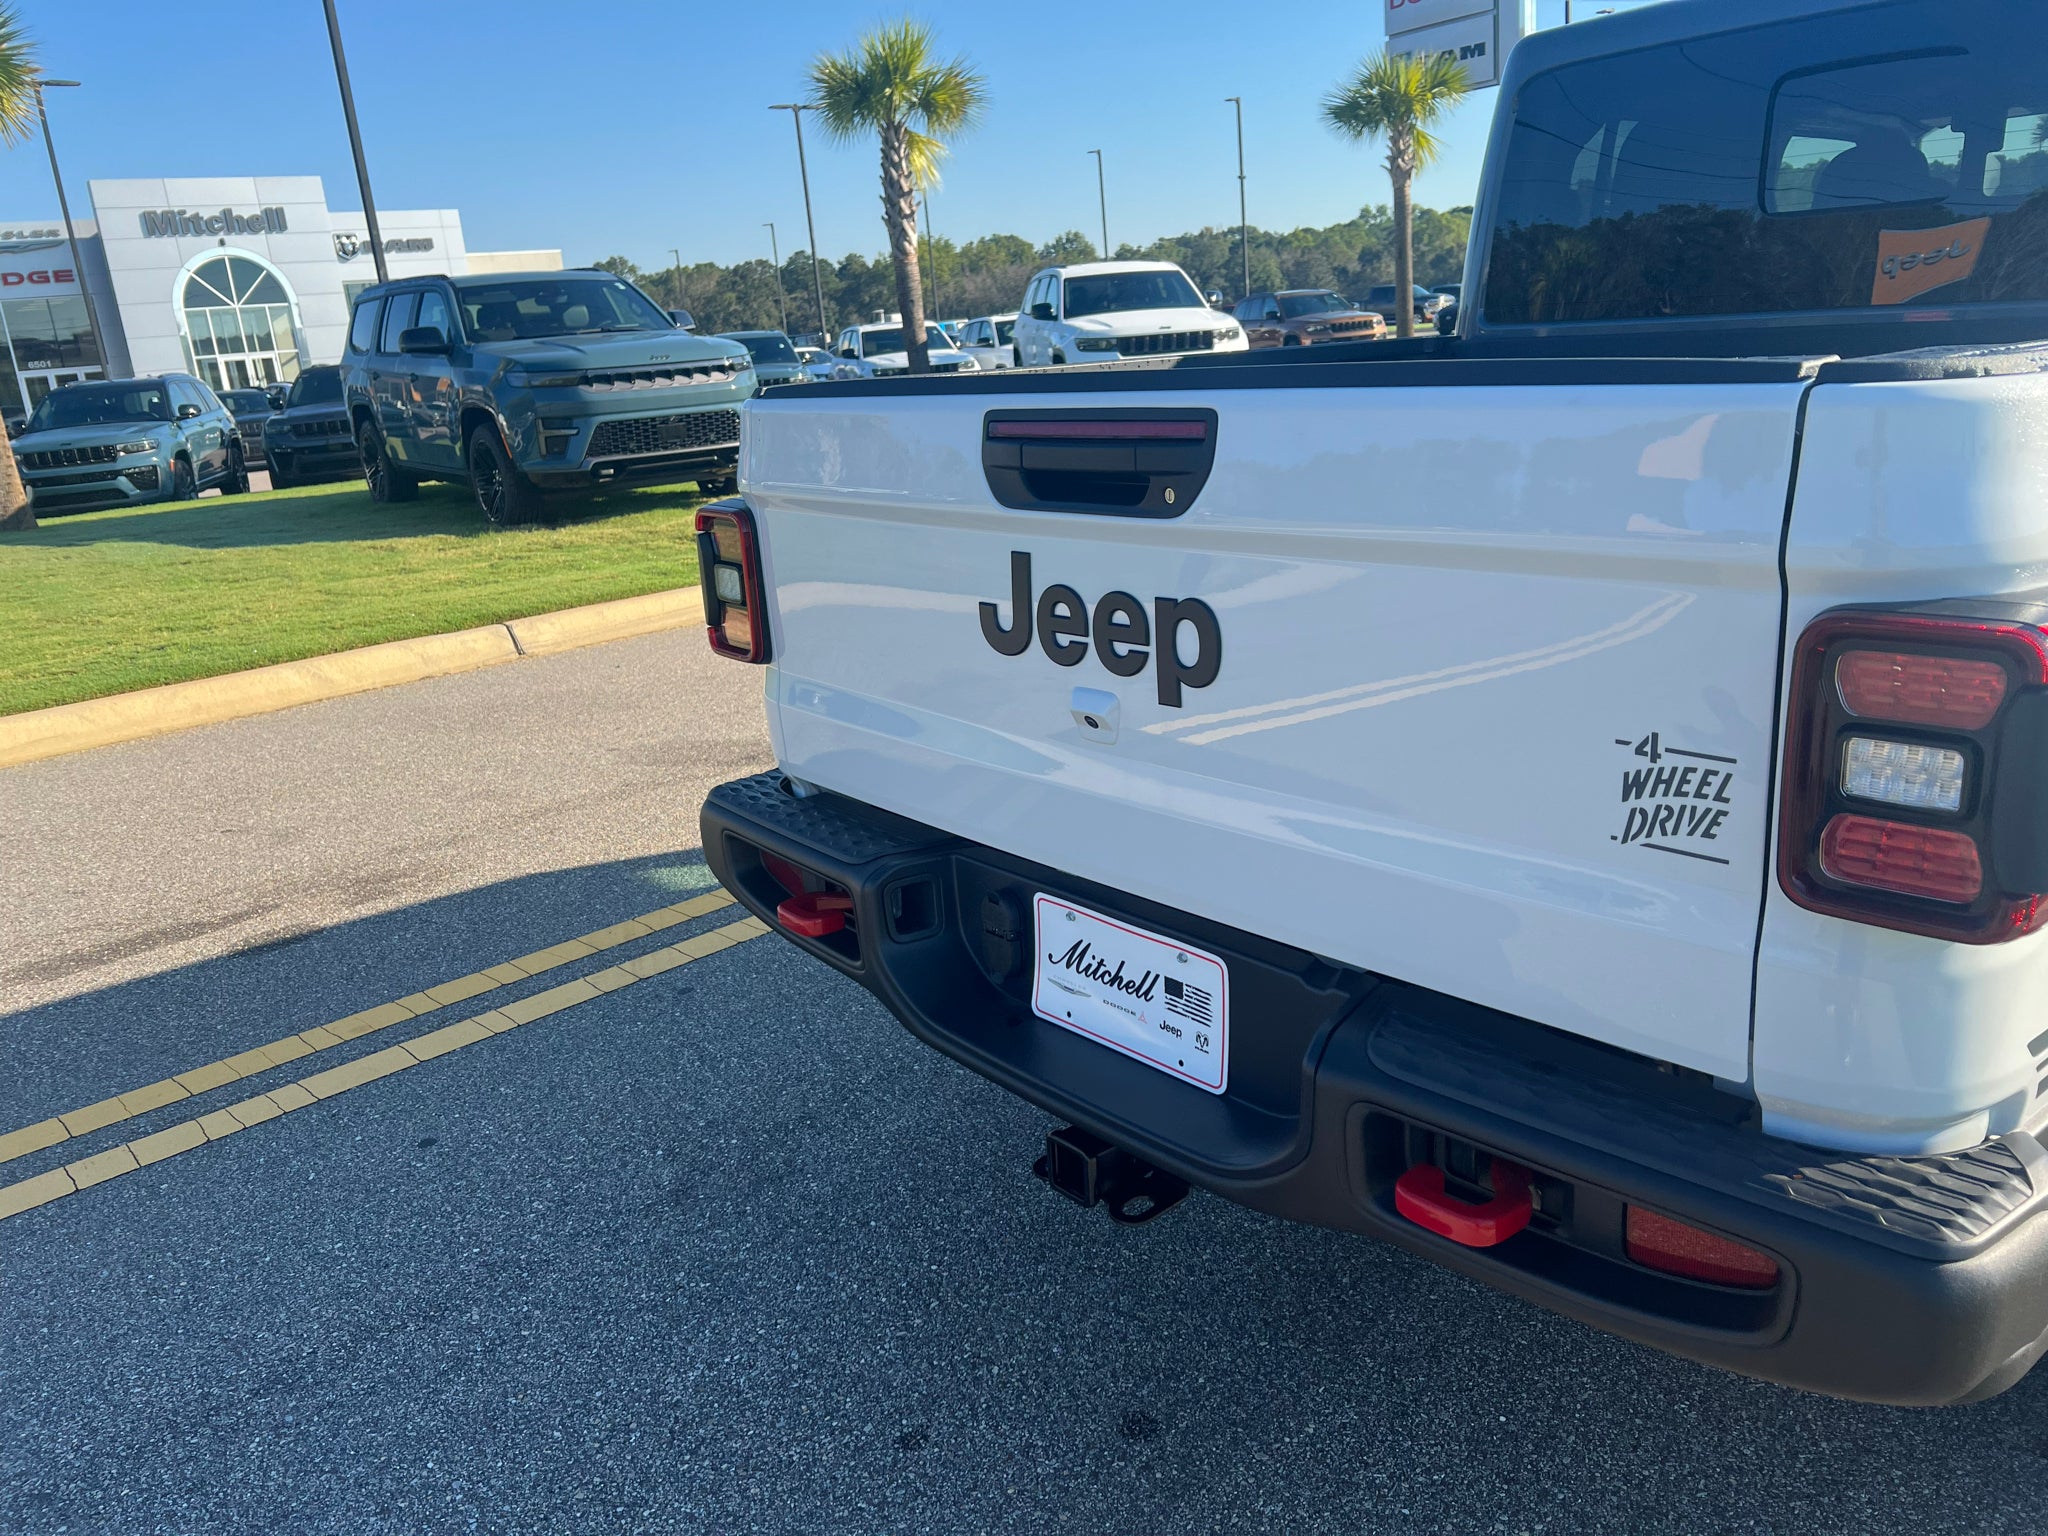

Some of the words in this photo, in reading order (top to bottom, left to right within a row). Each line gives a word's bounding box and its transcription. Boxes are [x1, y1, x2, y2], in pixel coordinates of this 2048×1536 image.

[139, 206, 288, 238] Mitchell
[28, 360, 51, 368] 6501
[979, 550, 1222, 708] Jeep
[1634, 732, 1662, 764] 4
[1621, 766, 1733, 804] WHEEL
[1621, 804, 1730, 844] DRIVE
[1048, 939, 1160, 1002] Mitchell
[1159, 1020, 1183, 1040] Jeep
